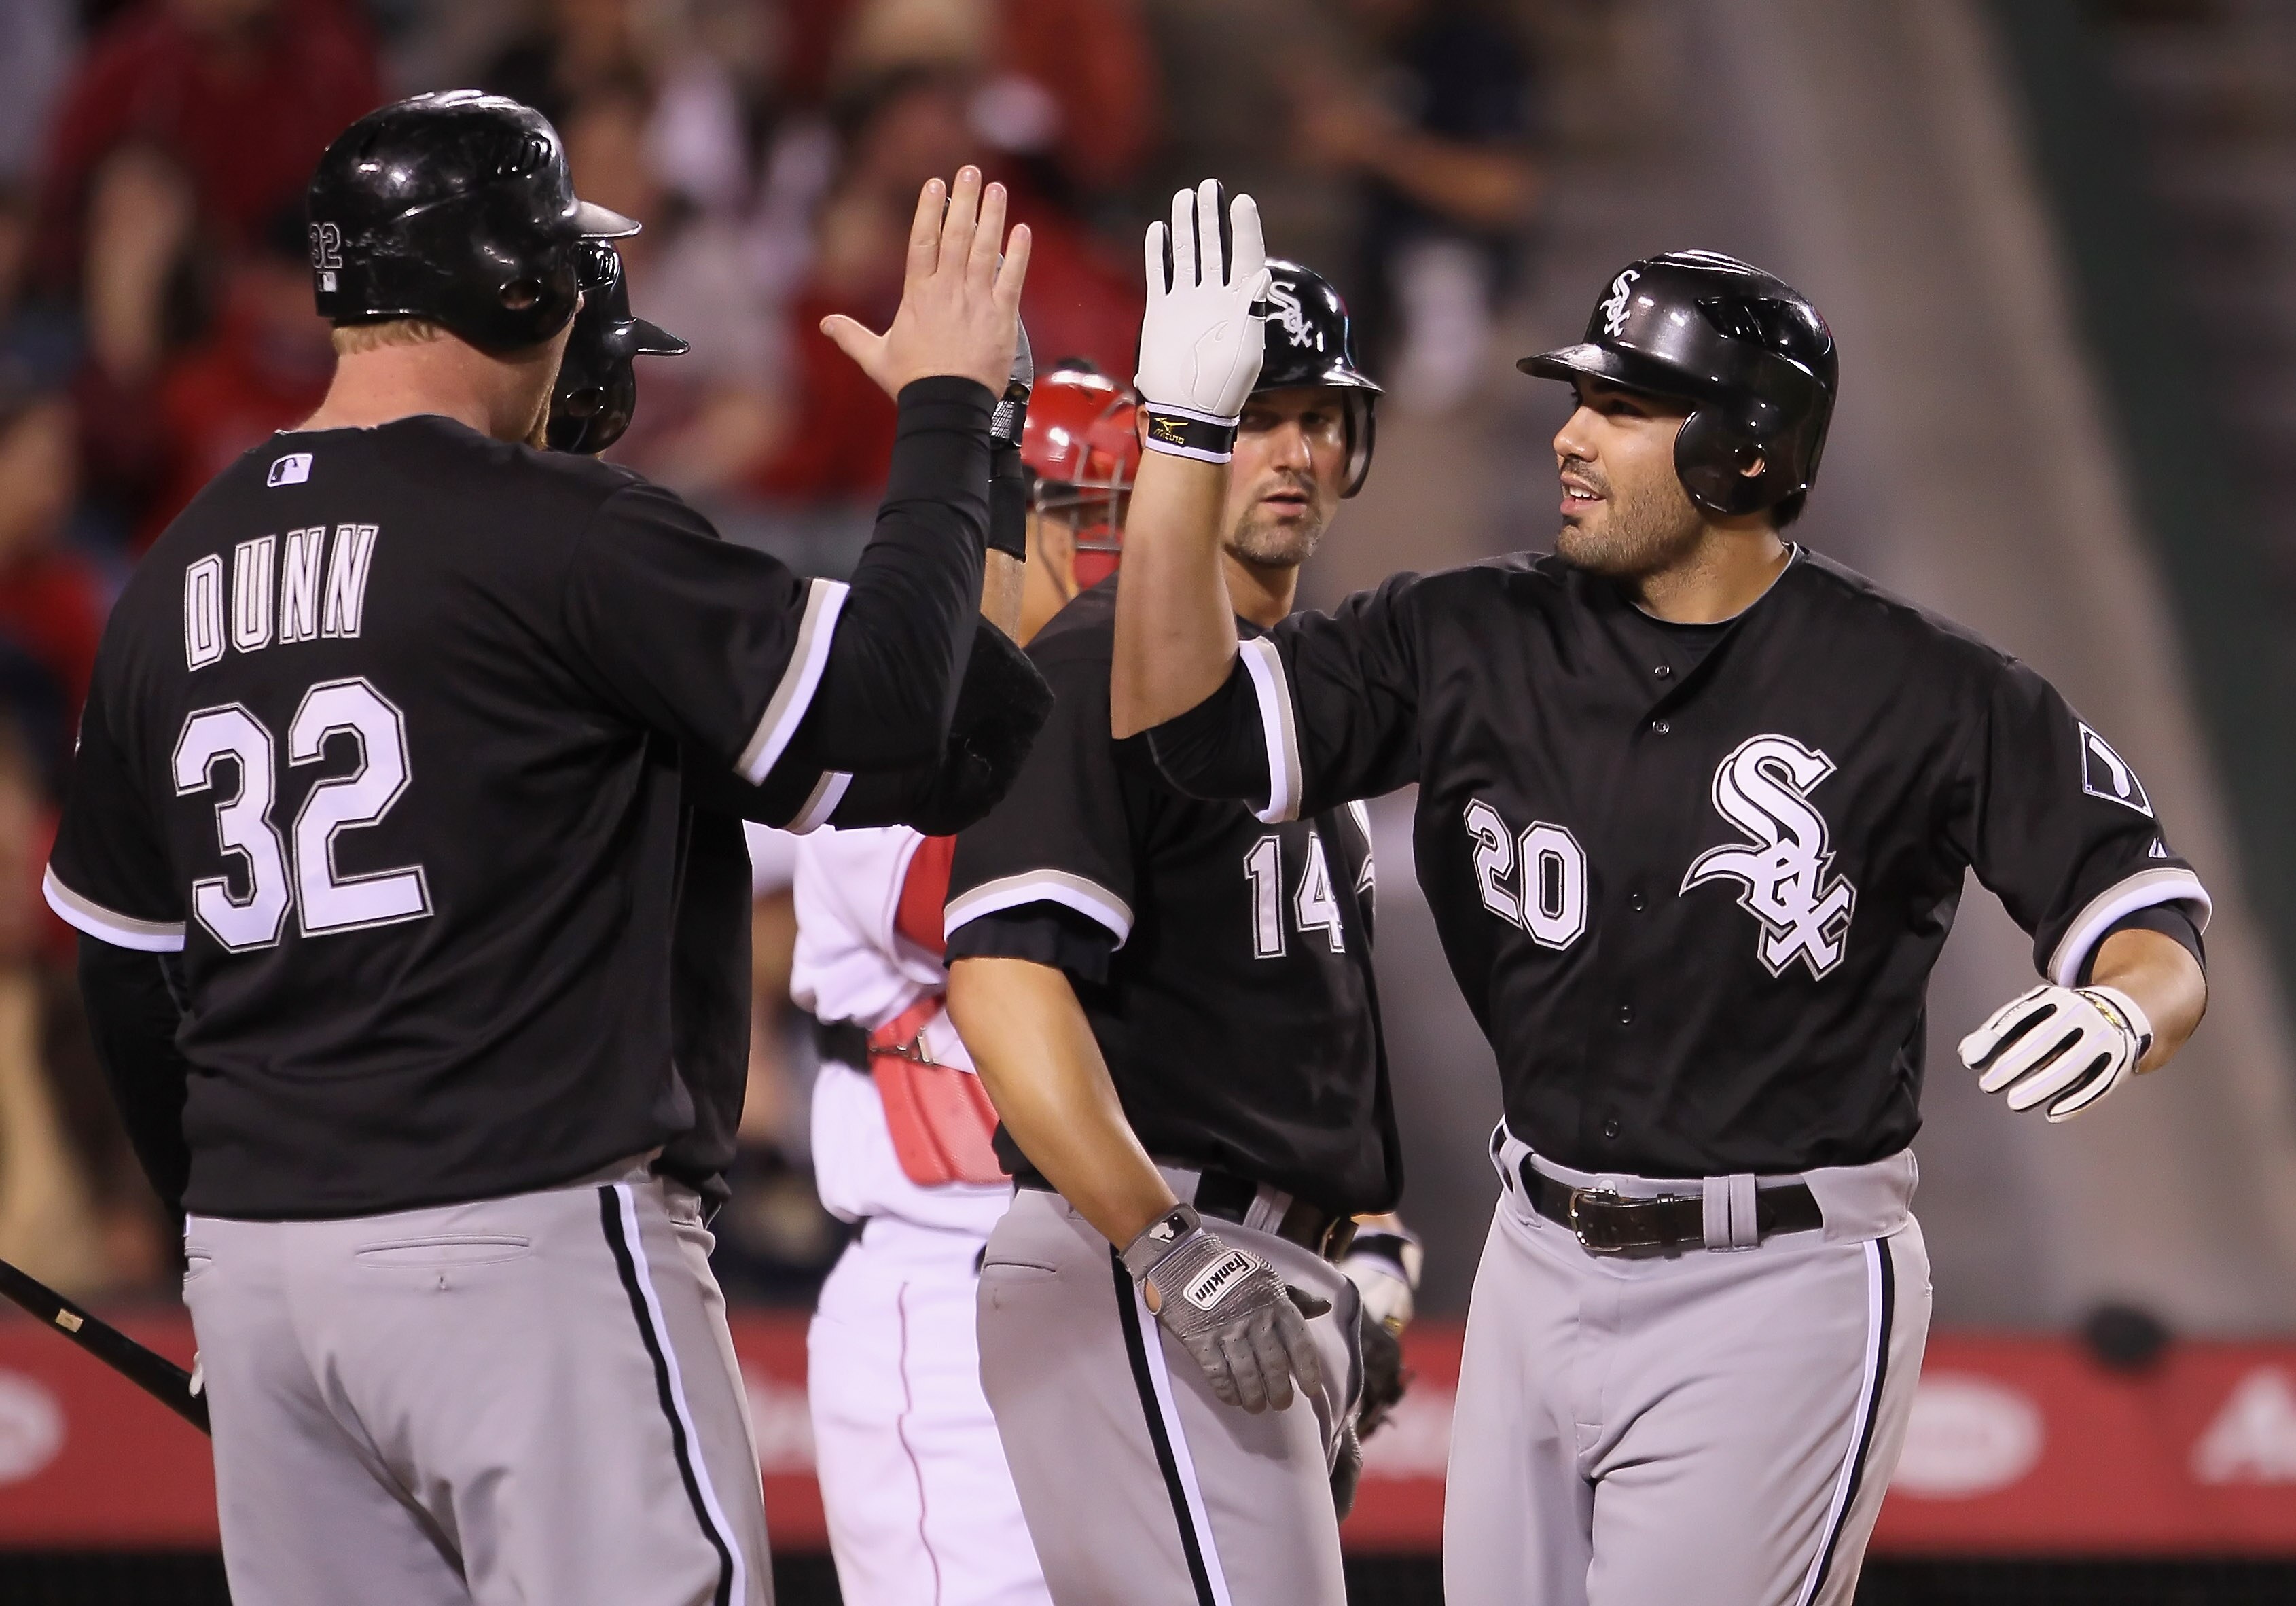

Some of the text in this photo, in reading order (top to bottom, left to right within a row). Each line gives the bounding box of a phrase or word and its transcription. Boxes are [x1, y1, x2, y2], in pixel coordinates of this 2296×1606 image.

[310, 221, 342, 268] 32
[185, 523, 378, 672] DUNN
[172, 677, 434, 954] 32
[1463, 798, 1588, 950] 20
[1243, 831, 1346, 960] 14
[1195, 1253, 1250, 1302] Franklin
